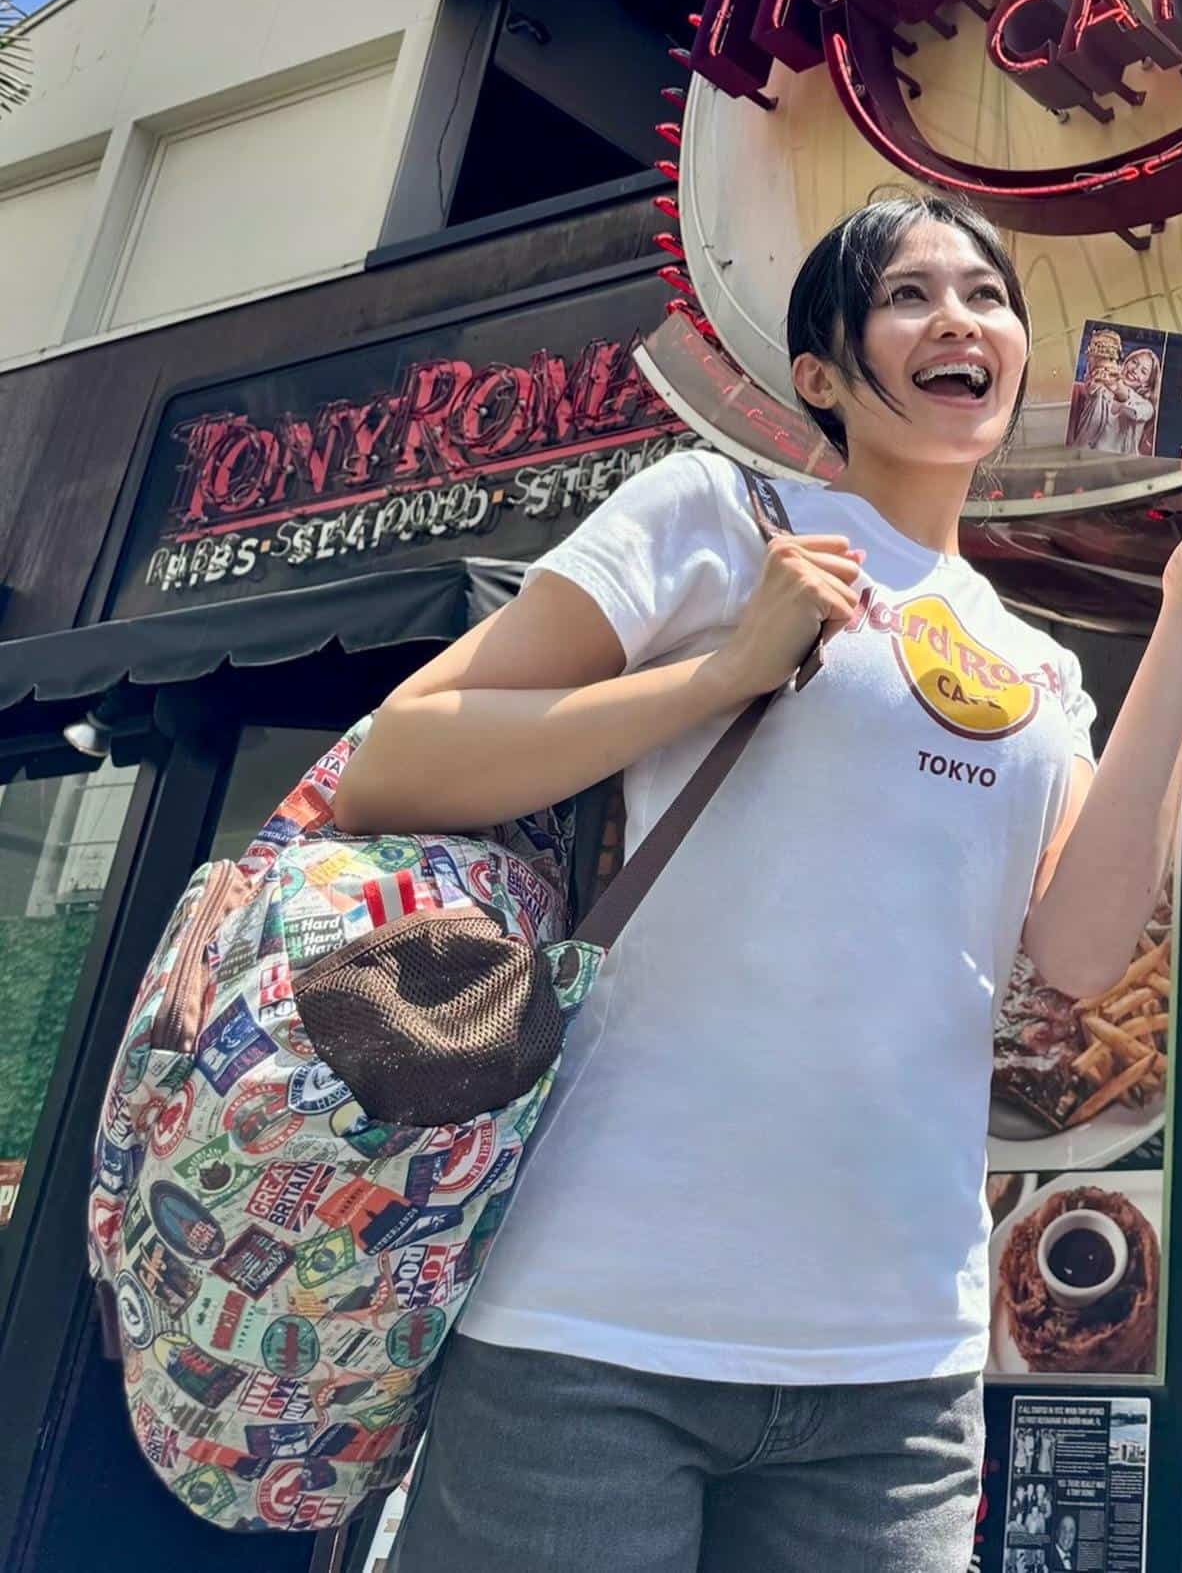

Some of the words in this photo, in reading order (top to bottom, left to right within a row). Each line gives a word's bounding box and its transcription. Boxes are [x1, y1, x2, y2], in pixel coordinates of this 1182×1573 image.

[917, 751, 997, 788] TOKYO
[301, 915, 341, 932] Hard
[303, 929, 344, 945] Hard
[250, 1162, 295, 1217] GREAT
[269, 1160, 318, 1225] BRITAIN
